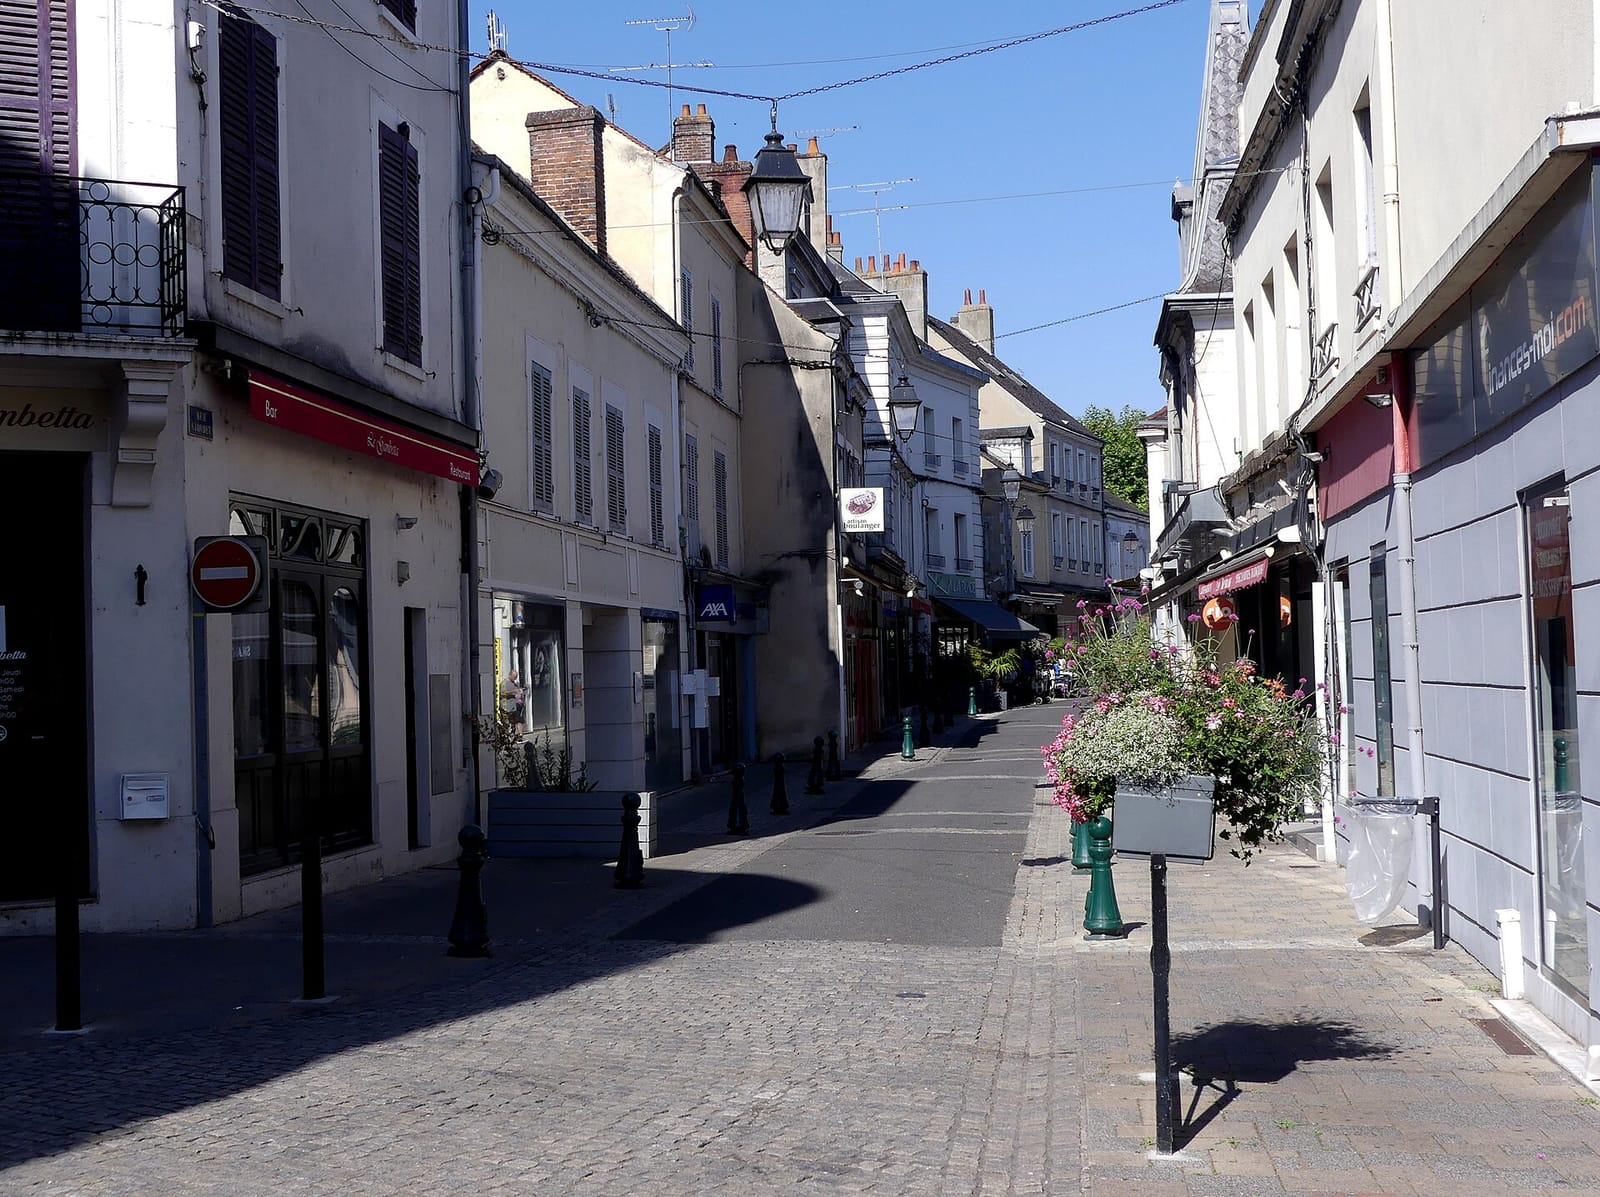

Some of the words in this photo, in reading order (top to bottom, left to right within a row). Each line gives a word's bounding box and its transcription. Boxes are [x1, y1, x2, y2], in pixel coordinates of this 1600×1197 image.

[265, 399, 279, 419] Bar
[449, 462, 471, 480] Restaurant
[843, 522, 881, 530] boulanger
[700, 602, 728, 617] AXA
